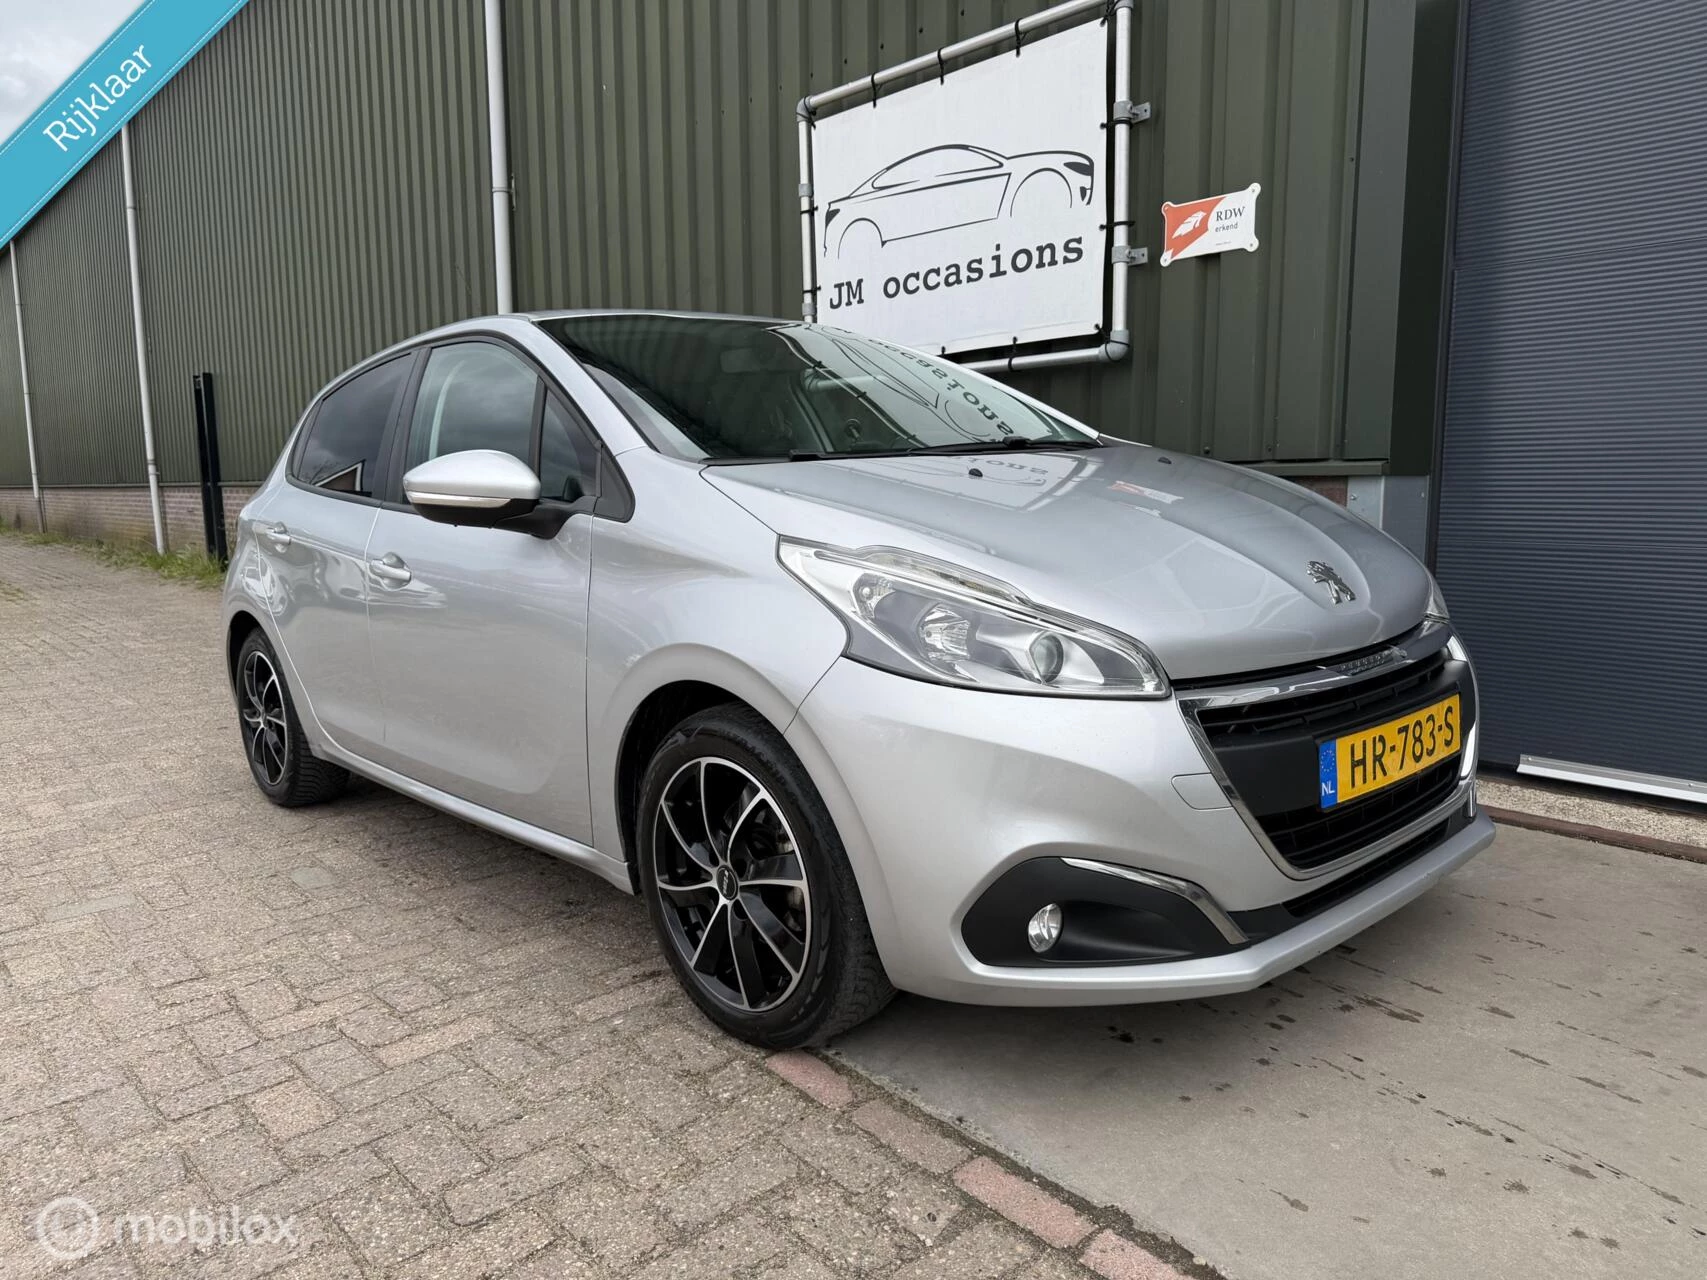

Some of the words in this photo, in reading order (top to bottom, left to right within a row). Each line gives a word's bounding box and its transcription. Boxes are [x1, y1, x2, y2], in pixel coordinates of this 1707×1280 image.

[1215, 206, 1246, 222] RDW
[1214, 222, 1239, 233] erkend
[829, 278, 865, 309] JM
[883, 236, 1084, 299] occasions
[1350, 706, 1454, 788] HR-783-S
[1321, 781, 1336, 796] NL
